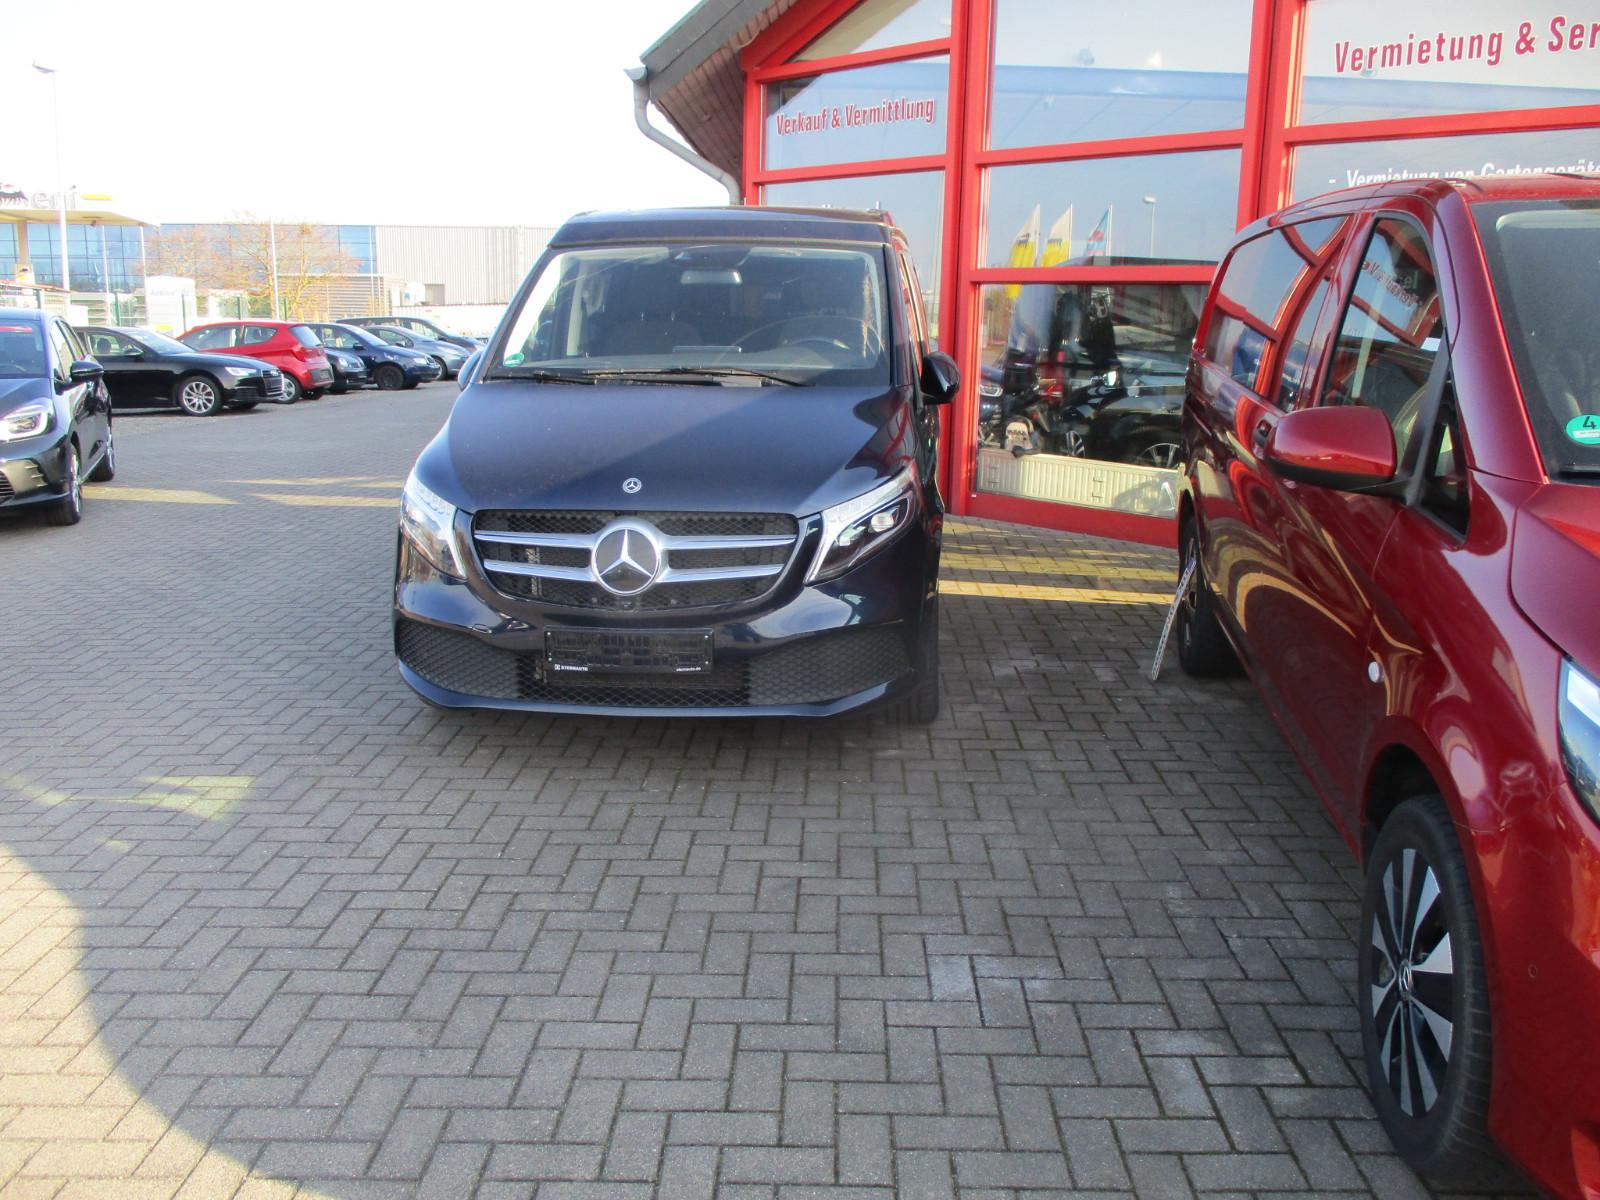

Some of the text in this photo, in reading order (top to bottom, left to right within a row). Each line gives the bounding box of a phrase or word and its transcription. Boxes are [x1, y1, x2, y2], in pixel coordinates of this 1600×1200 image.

[1334, 15, 1600, 73] Vermietung & Ser
[776, 97, 936, 136] Verkauf & Vermittlung
[1582, 415, 1596, 429] 4
